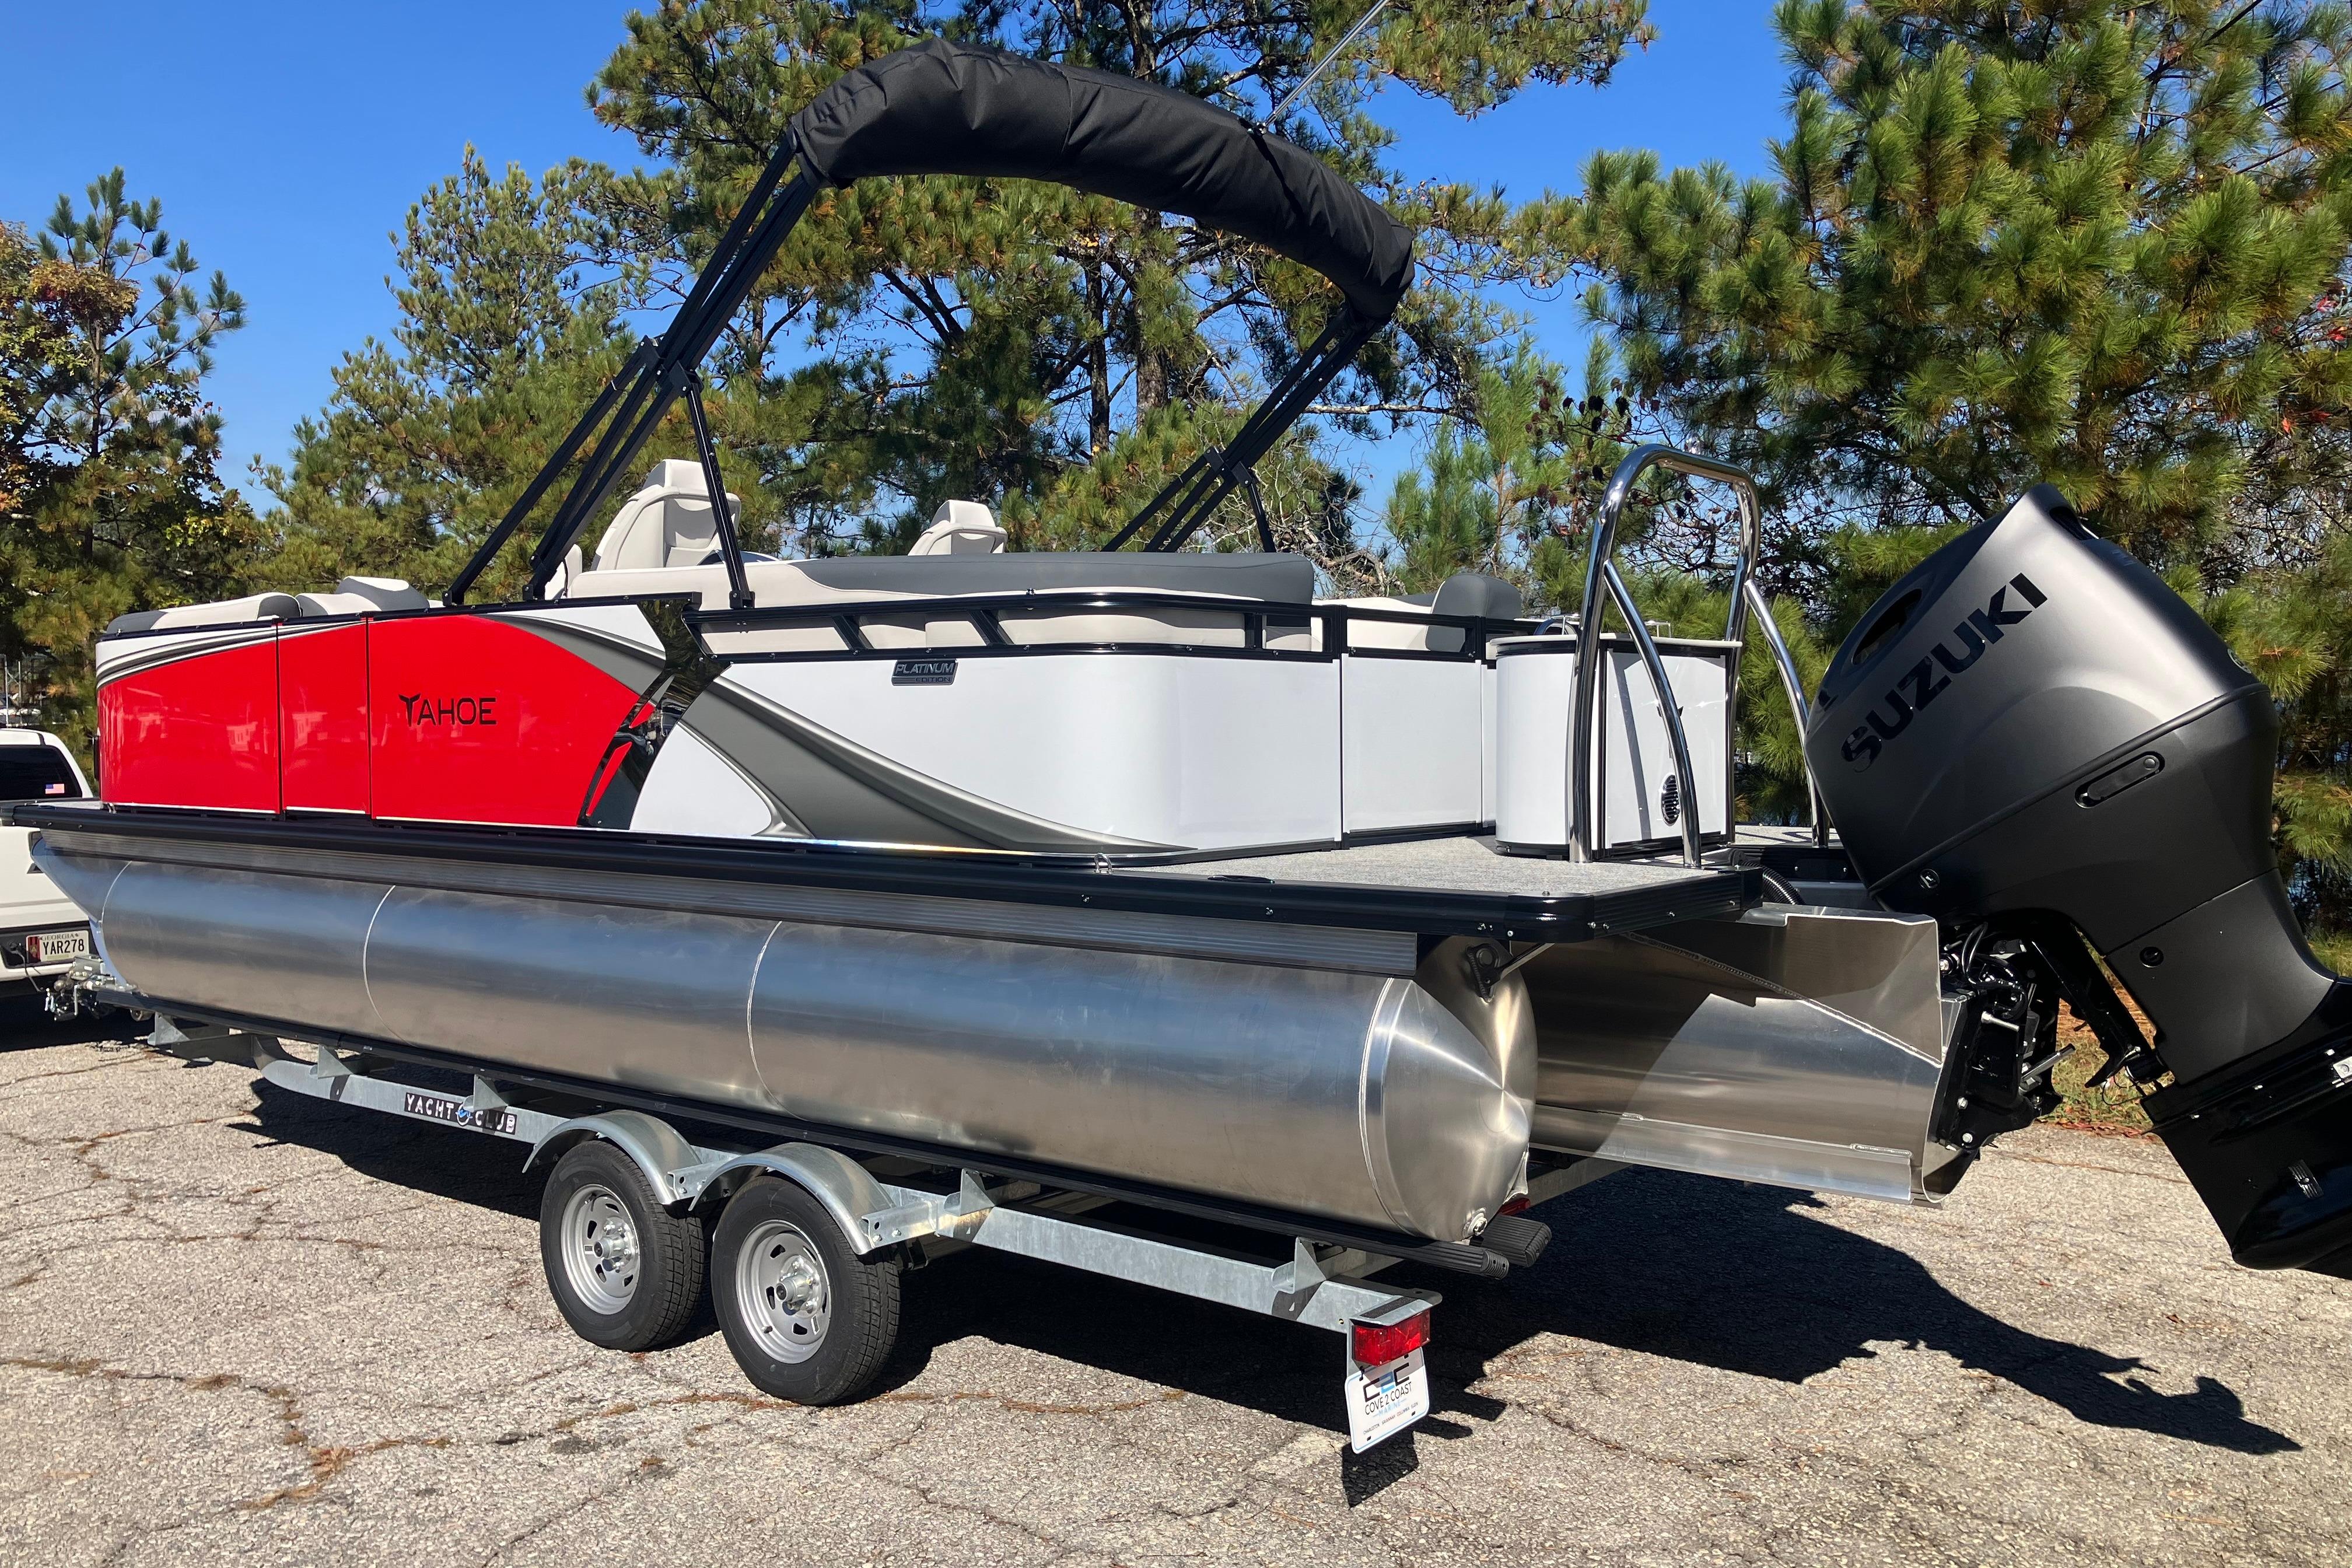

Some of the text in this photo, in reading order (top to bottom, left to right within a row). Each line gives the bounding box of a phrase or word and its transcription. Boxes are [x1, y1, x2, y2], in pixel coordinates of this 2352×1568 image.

[895, 663, 955, 674] PLATINUM
[1840, 572, 2048, 772] SUZUKI
[398, 692, 498, 727] TAHOE
[43, 939, 85, 955] YAR278
[407, 1094, 516, 1133] YACHT CLUB
[1365, 1381, 1412, 1415] COVE 2 COAST
[1378, 1399, 1401, 1416] MARINE
